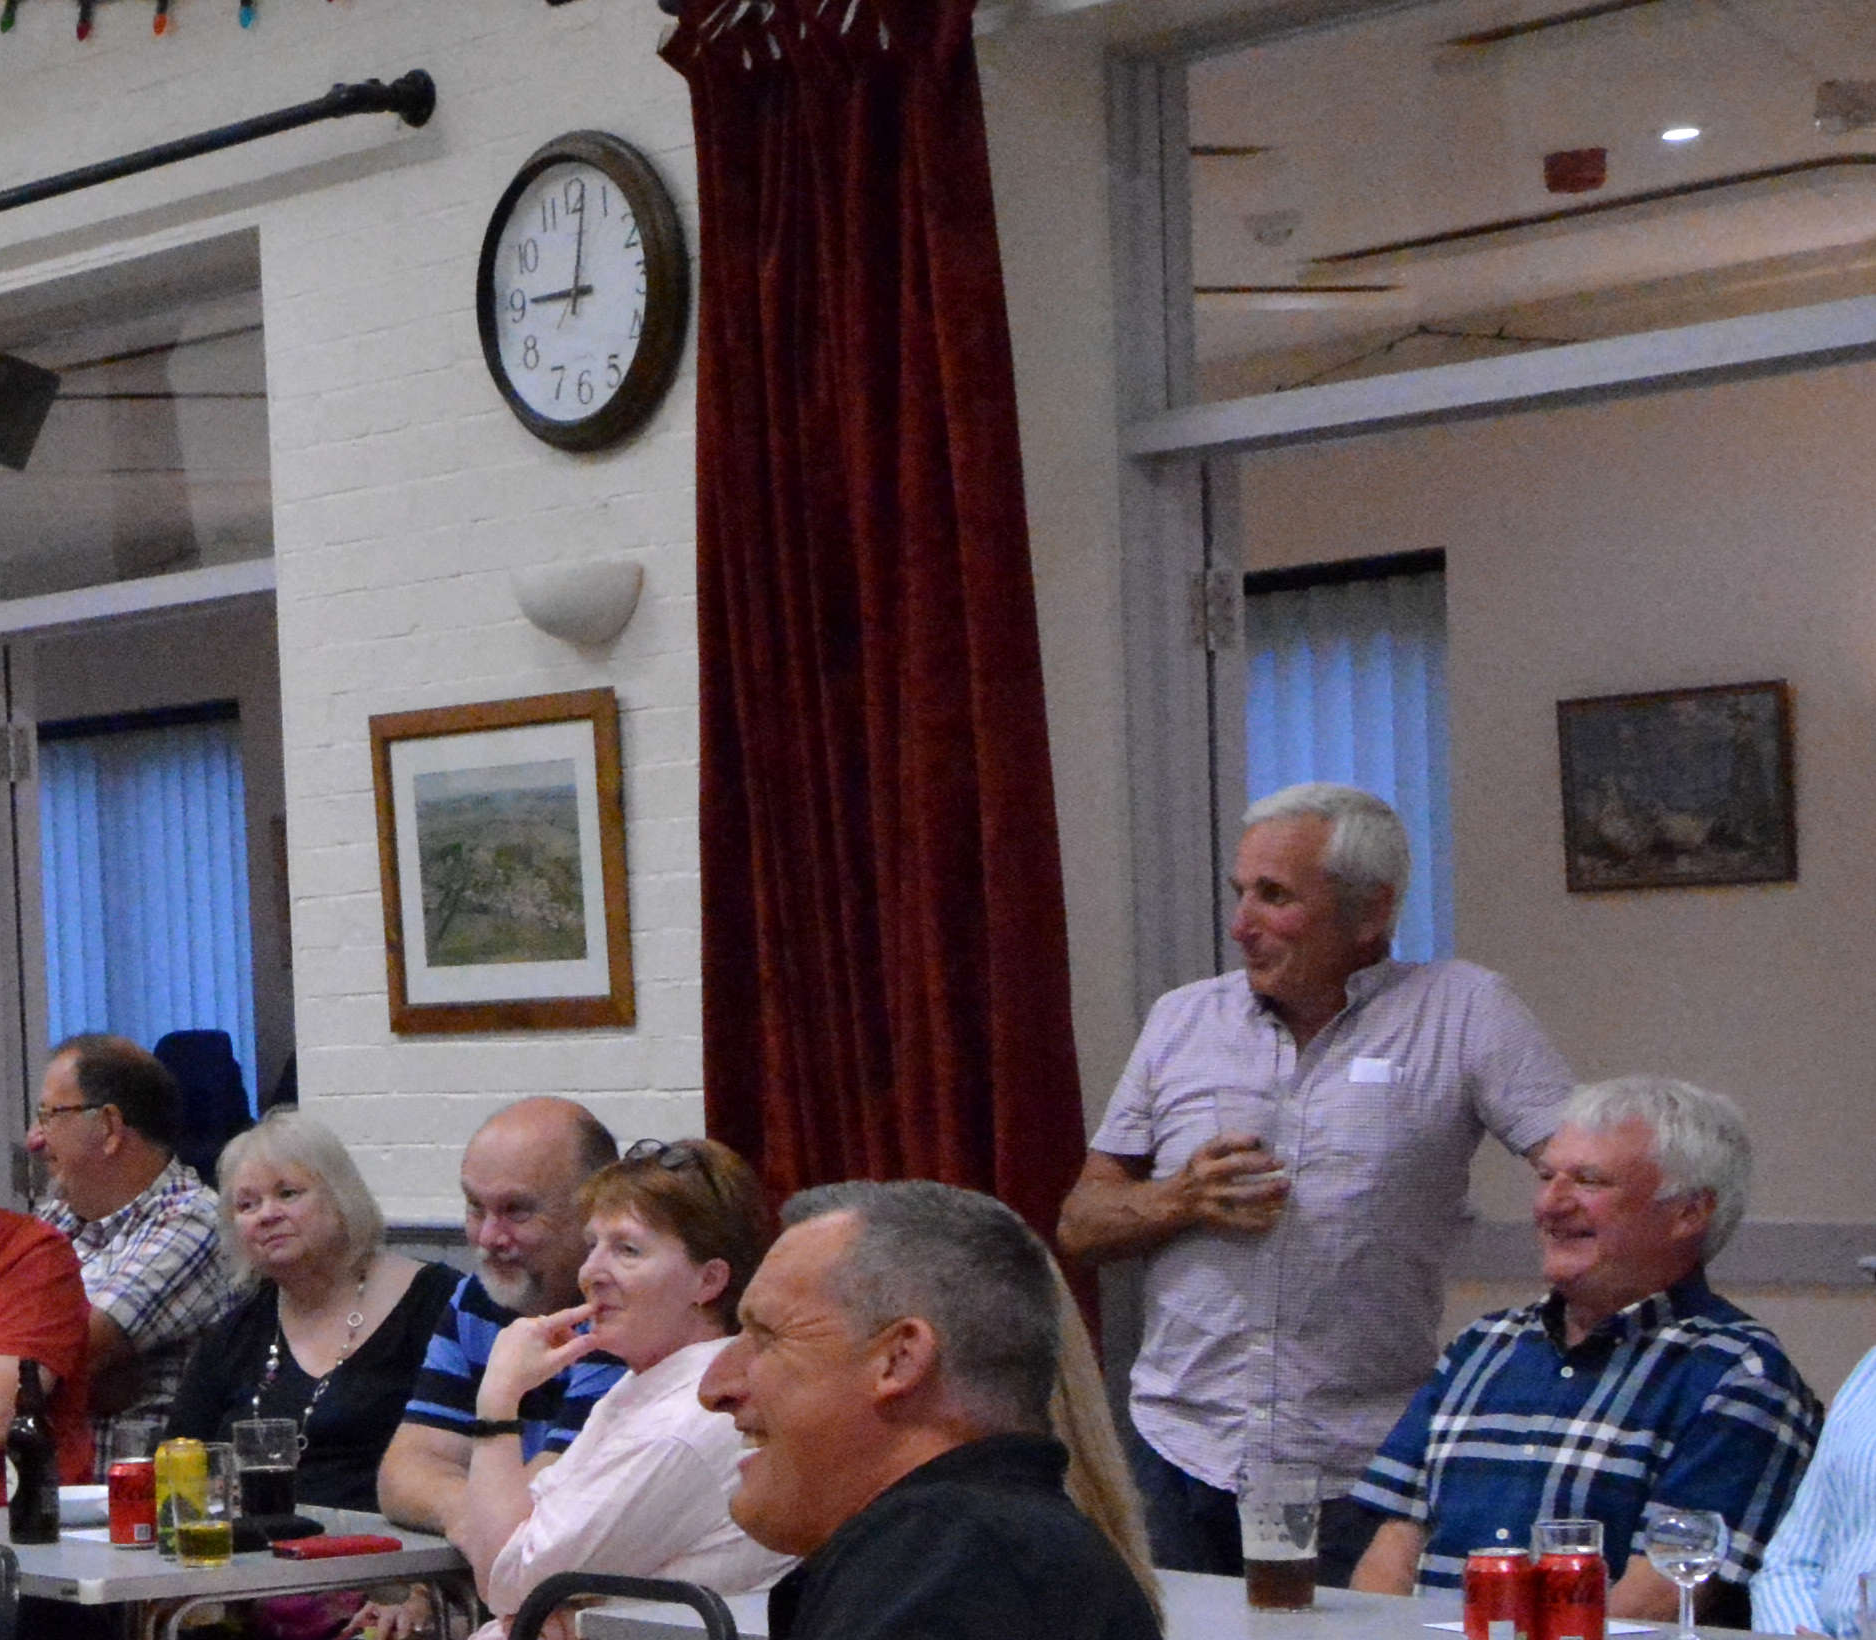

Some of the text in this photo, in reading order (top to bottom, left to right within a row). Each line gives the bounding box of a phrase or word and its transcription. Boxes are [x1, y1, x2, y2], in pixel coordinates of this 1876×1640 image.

[564, 178, 585, 215] 12
[601, 185, 609, 217] 1
[541, 197, 557, 233] 11
[621, 212, 639, 249] 2
[518, 238, 539, 275] 10
[509, 289, 526, 323] 9
[522, 335, 540, 370] 8
[550, 365, 566, 401] 7
[577, 369, 594, 405] 6
[606, 354, 622, 389] 5
